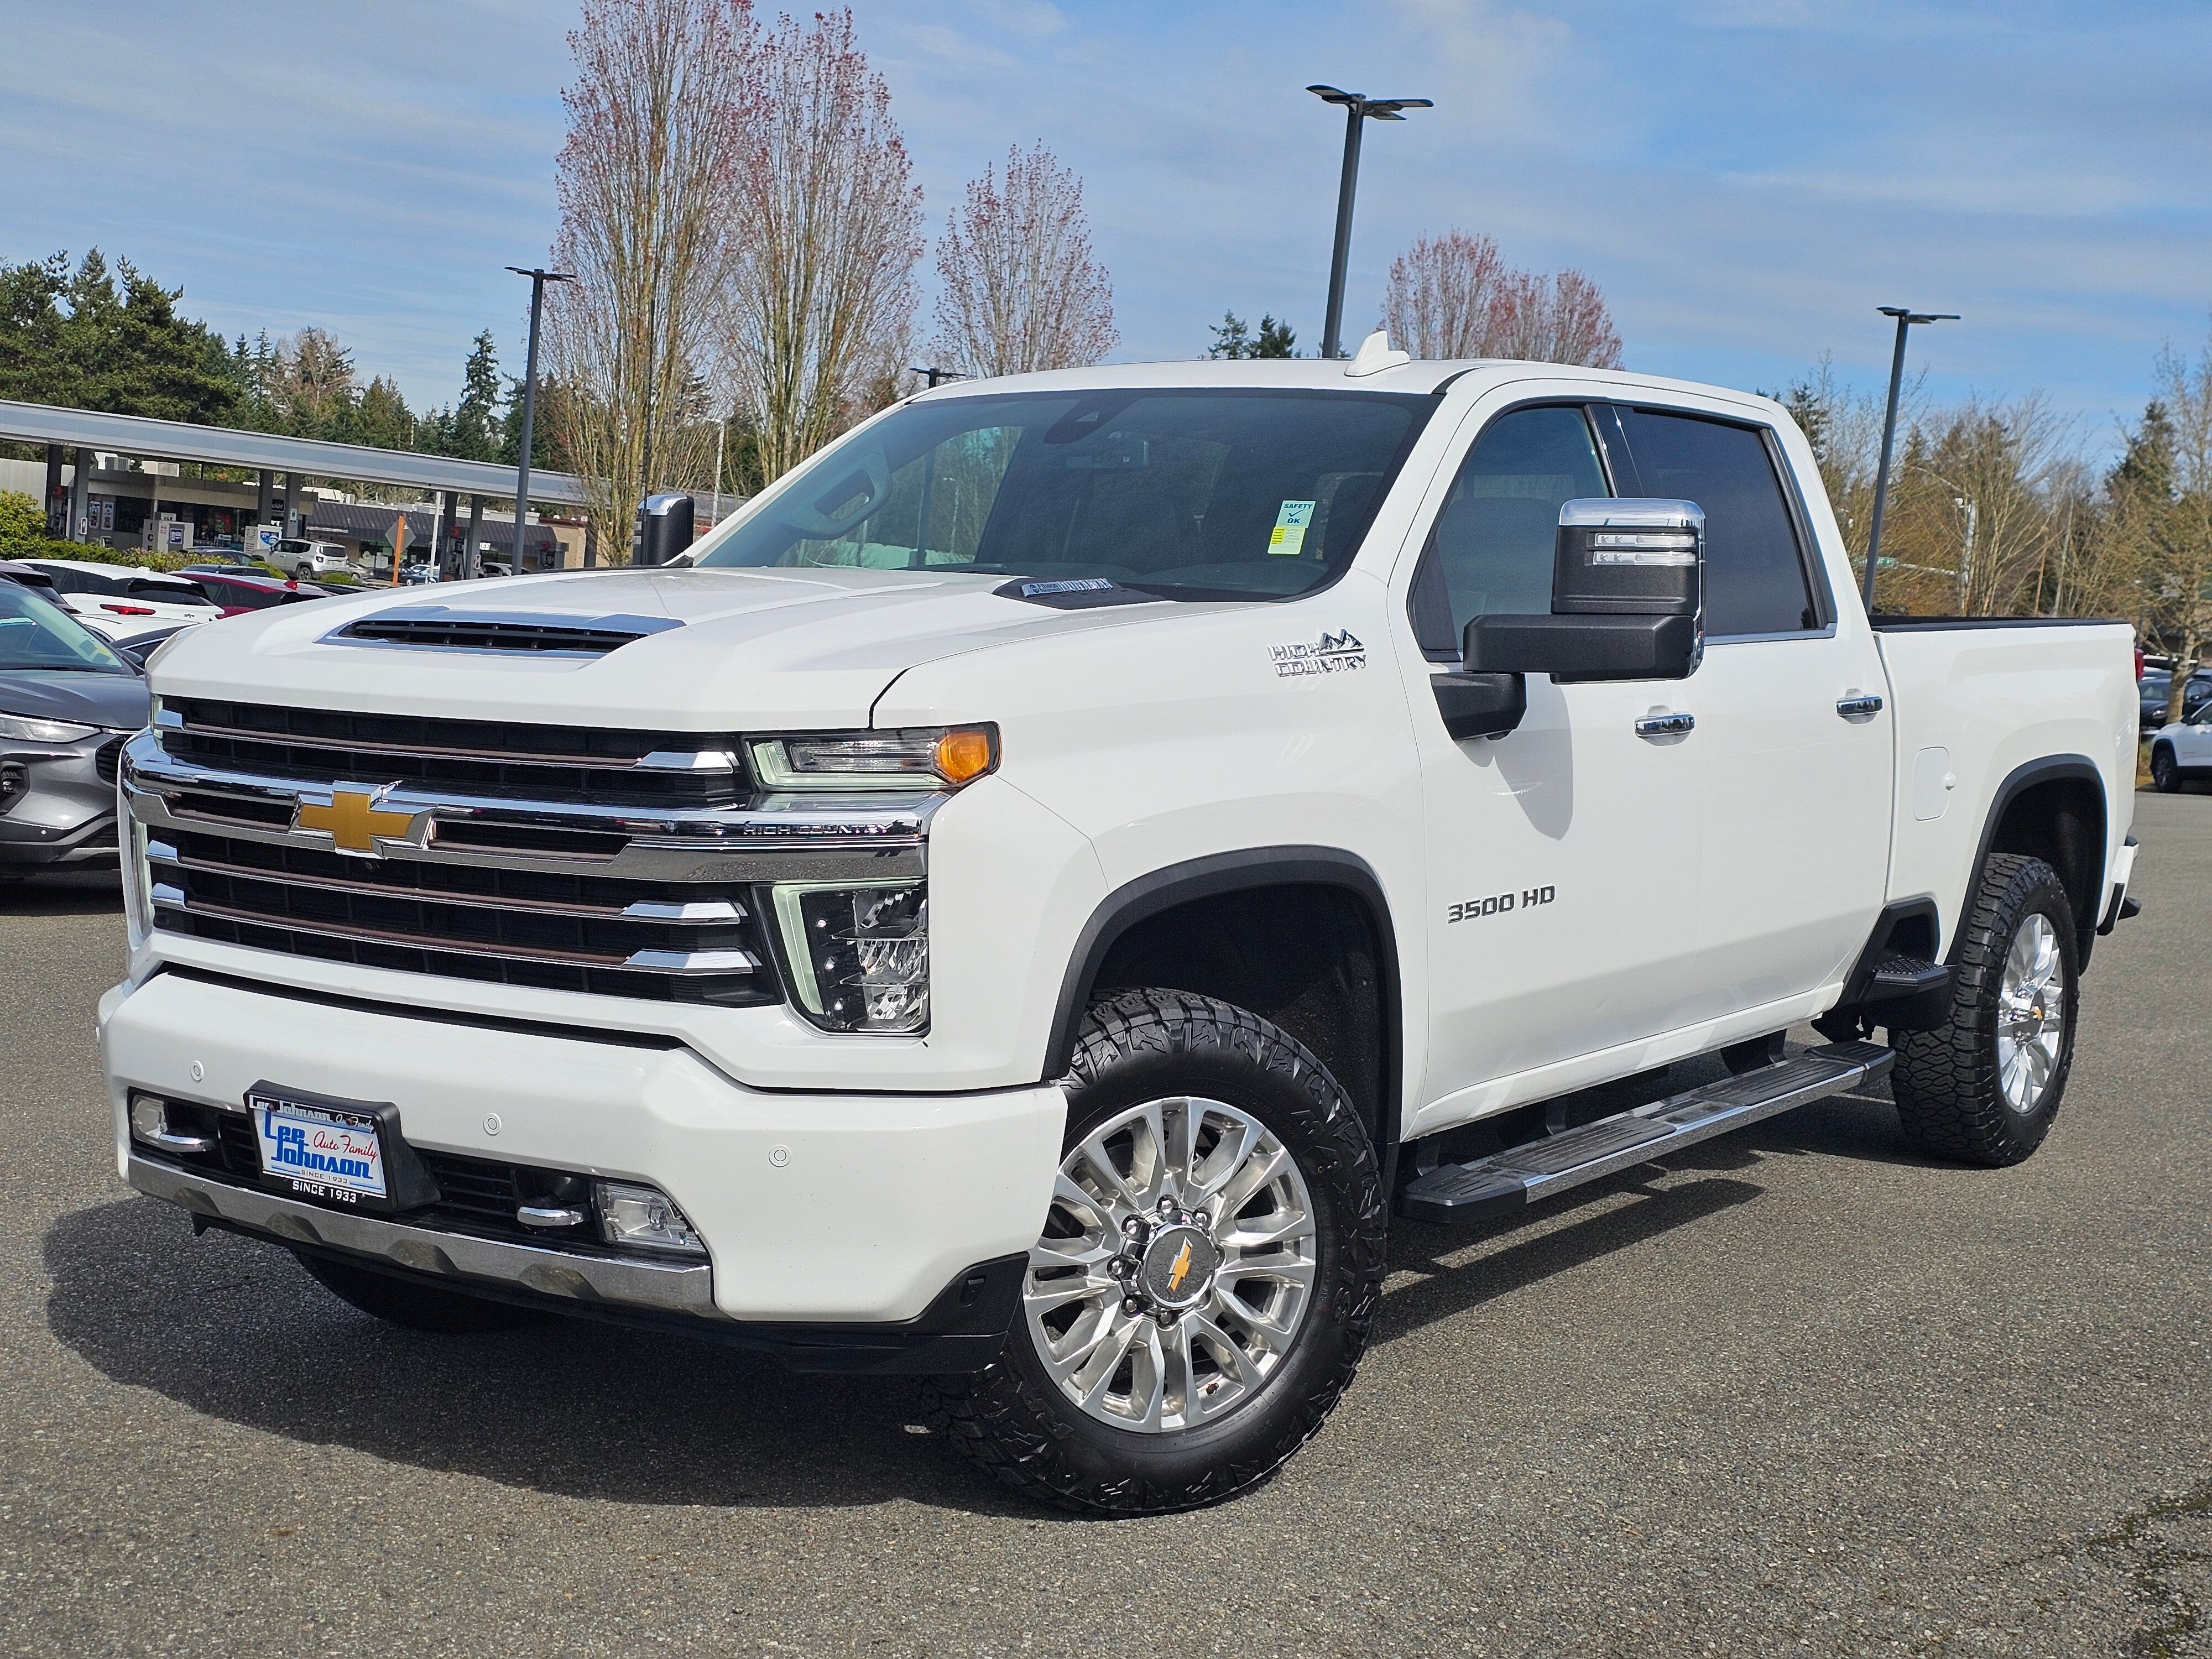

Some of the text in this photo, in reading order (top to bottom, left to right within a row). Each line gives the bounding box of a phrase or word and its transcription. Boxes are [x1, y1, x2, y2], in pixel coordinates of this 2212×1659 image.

[1267, 643, 1322, 661] HIGH
[1275, 655, 1366, 677] COUNTRY
[1448, 885, 1555, 924] 3500 HD
[264, 1112, 309, 1147] Lee
[271, 1138, 373, 1180] Johnson
[314, 1130, 378, 1165] Auto Family
[292, 1180, 357, 1203] SINCE 1933
[301, 1170, 348, 1185] SINCE 1933
